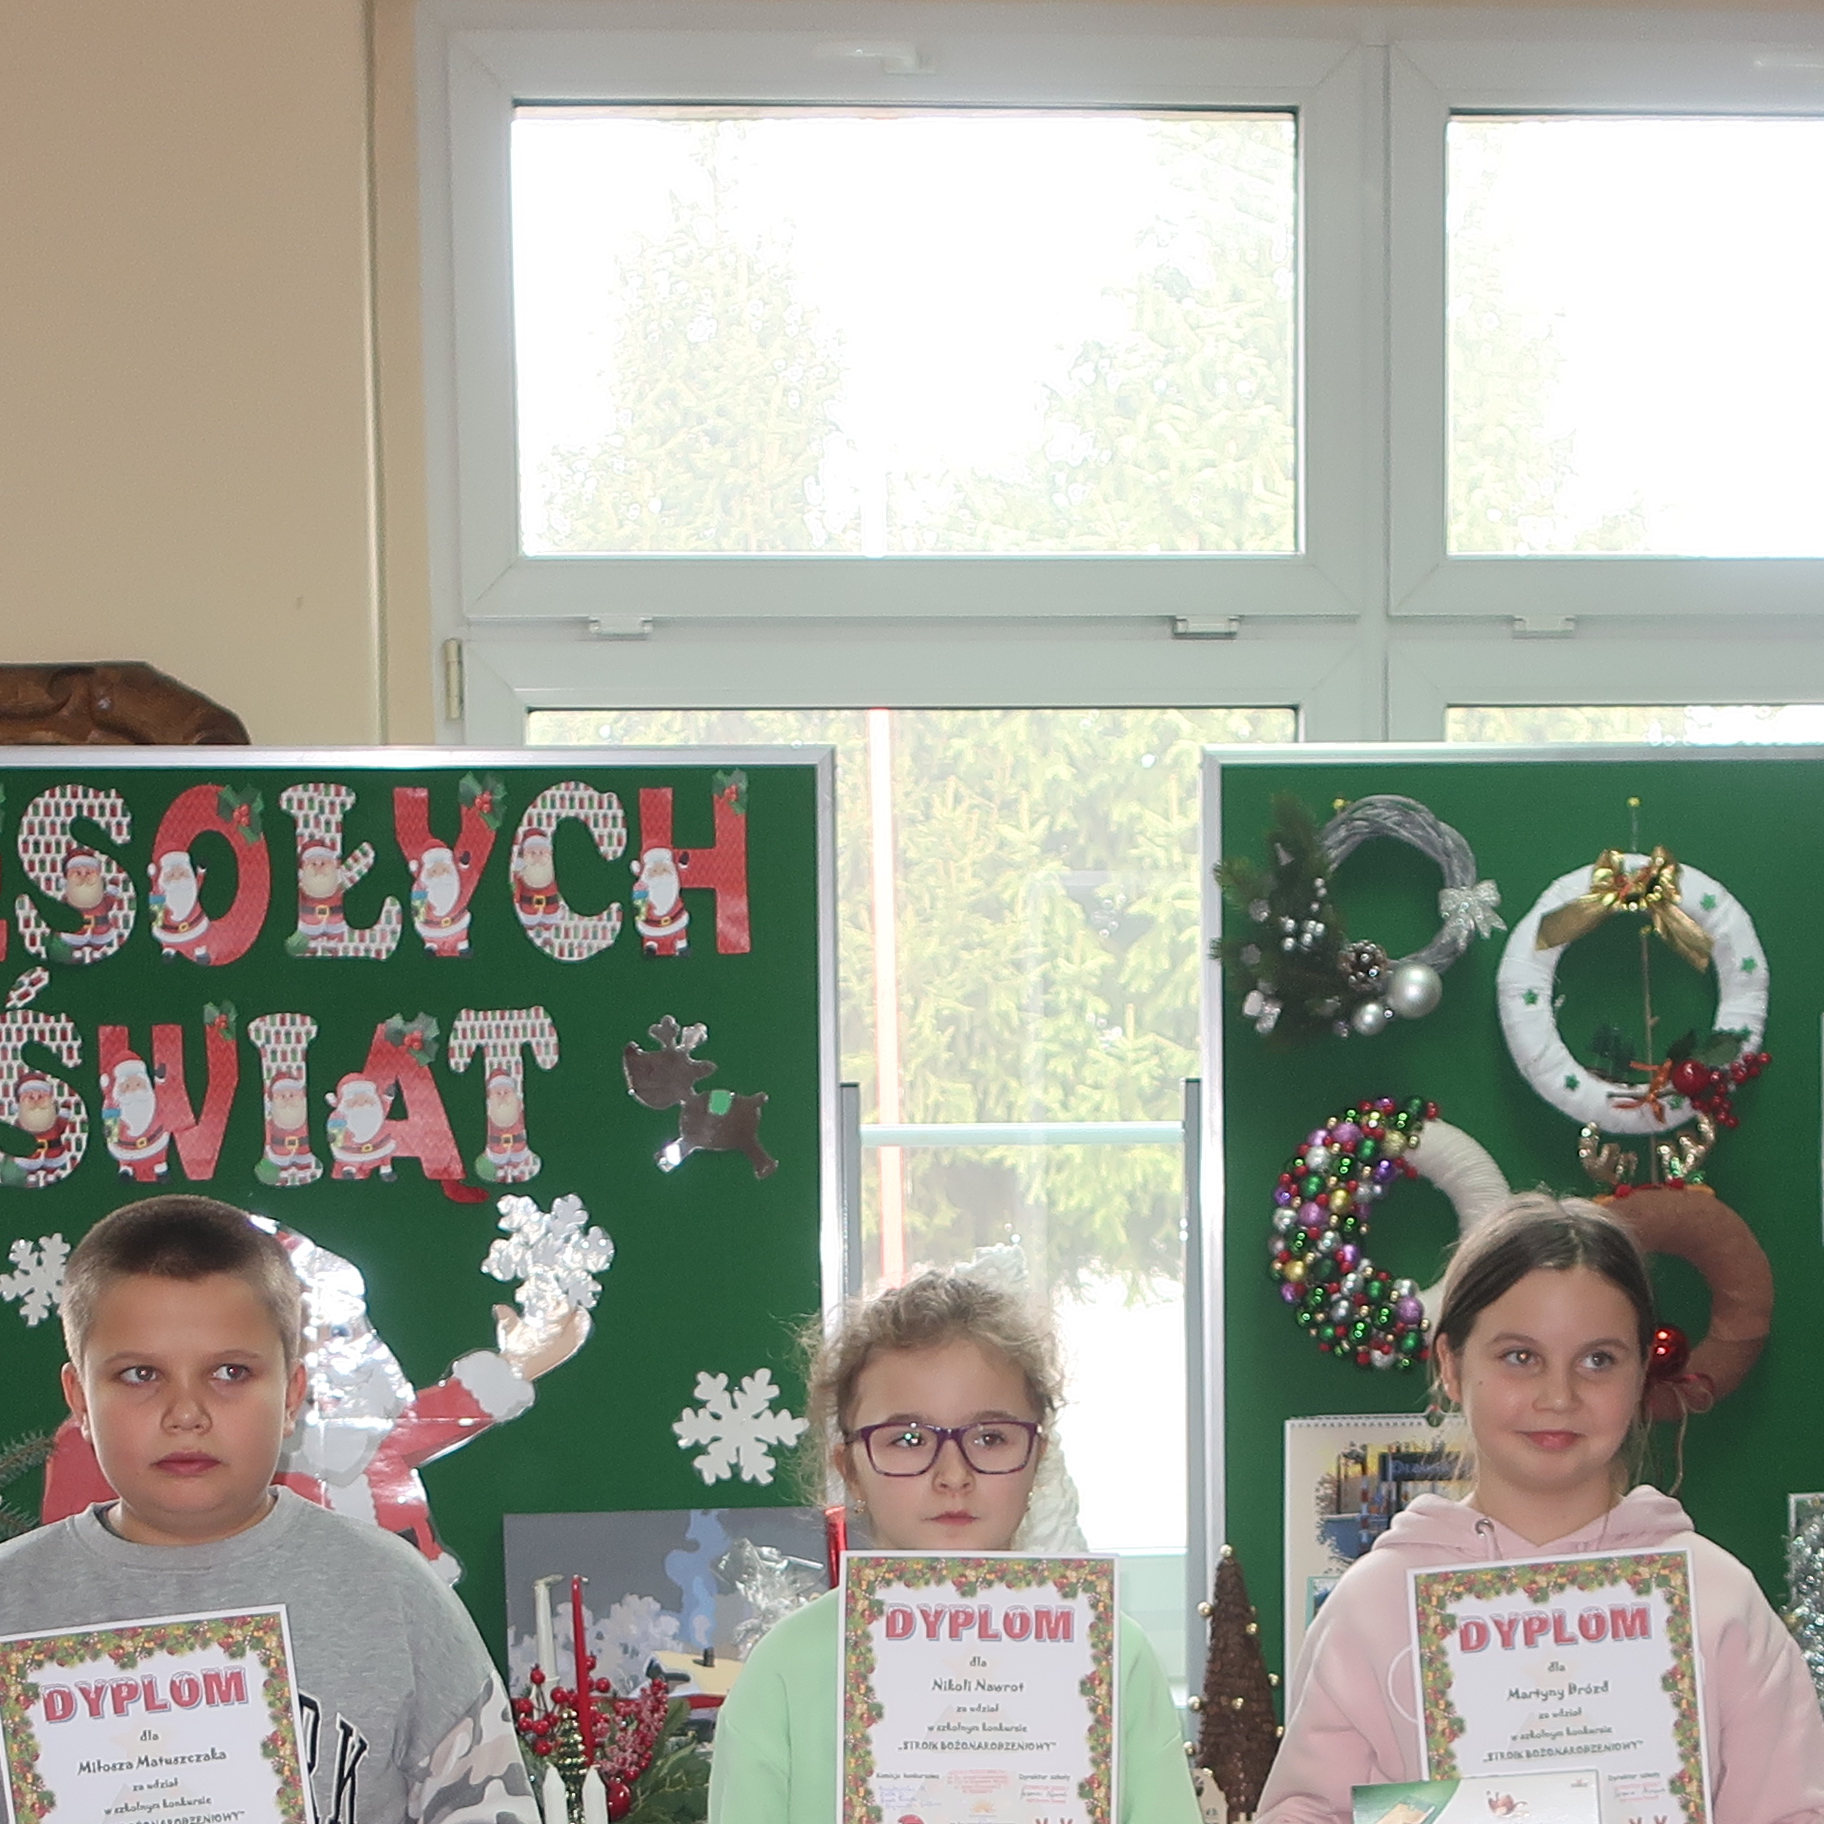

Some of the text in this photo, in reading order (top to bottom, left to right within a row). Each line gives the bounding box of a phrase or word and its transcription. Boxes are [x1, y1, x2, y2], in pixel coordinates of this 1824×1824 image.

[885, 1603, 1074, 1642] DYPLOM
[1459, 1602, 1651, 1653] DYPLOM
[969, 1656, 987, 1667] dla
[1547, 1662, 1566, 1672] dla
[931, 1678, 1024, 1692] Nikoli Nawrot
[1507, 1684, 1565, 1702] Martyny
[40, 1666, 249, 1724] DYPLOM
[140, 1730, 159, 1742] dla
[77, 1748, 227, 1777] Miłosza Matuszczaka
